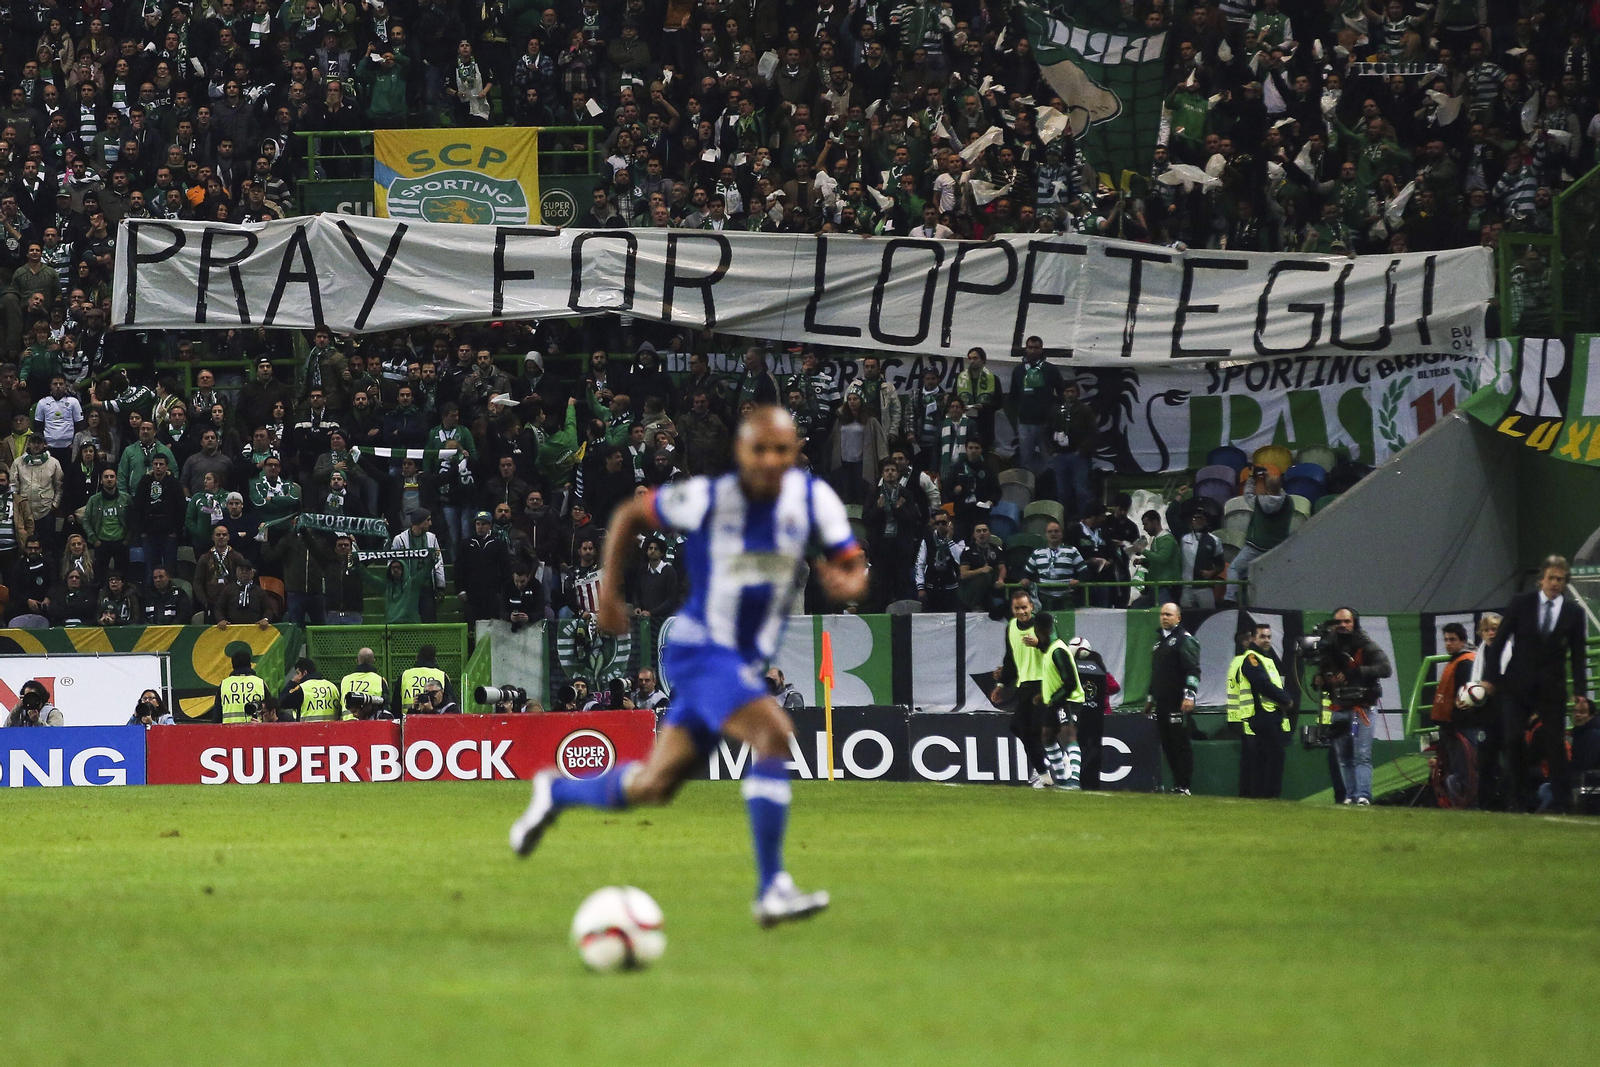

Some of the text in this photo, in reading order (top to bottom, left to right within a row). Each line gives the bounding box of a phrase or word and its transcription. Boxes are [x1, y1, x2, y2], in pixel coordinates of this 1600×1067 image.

[406, 143, 508, 173] SCP
[400, 179, 513, 205] SPORTING
[543, 201, 570, 210] SUPER
[544, 209, 569, 218] BOCK
[124, 219, 1438, 359] PRAY FOR LOPETEGUI
[1451, 326, 1472, 338] BU
[815, 355, 965, 393] BRGADA
[1206, 355, 1372, 395] SPORTING
[305, 512, 387, 534] SPORTING
[230, 681, 255, 694] 019
[312, 686, 332, 699] 391
[349, 680, 370, 693] 172
[200, 738, 518, 785] SUPER BOCK
[565, 746, 605, 758] SUPER
[568, 756, 604, 768] BOCK
[911, 735, 1133, 783] CLIC
[0, 746, 128, 787] NG
